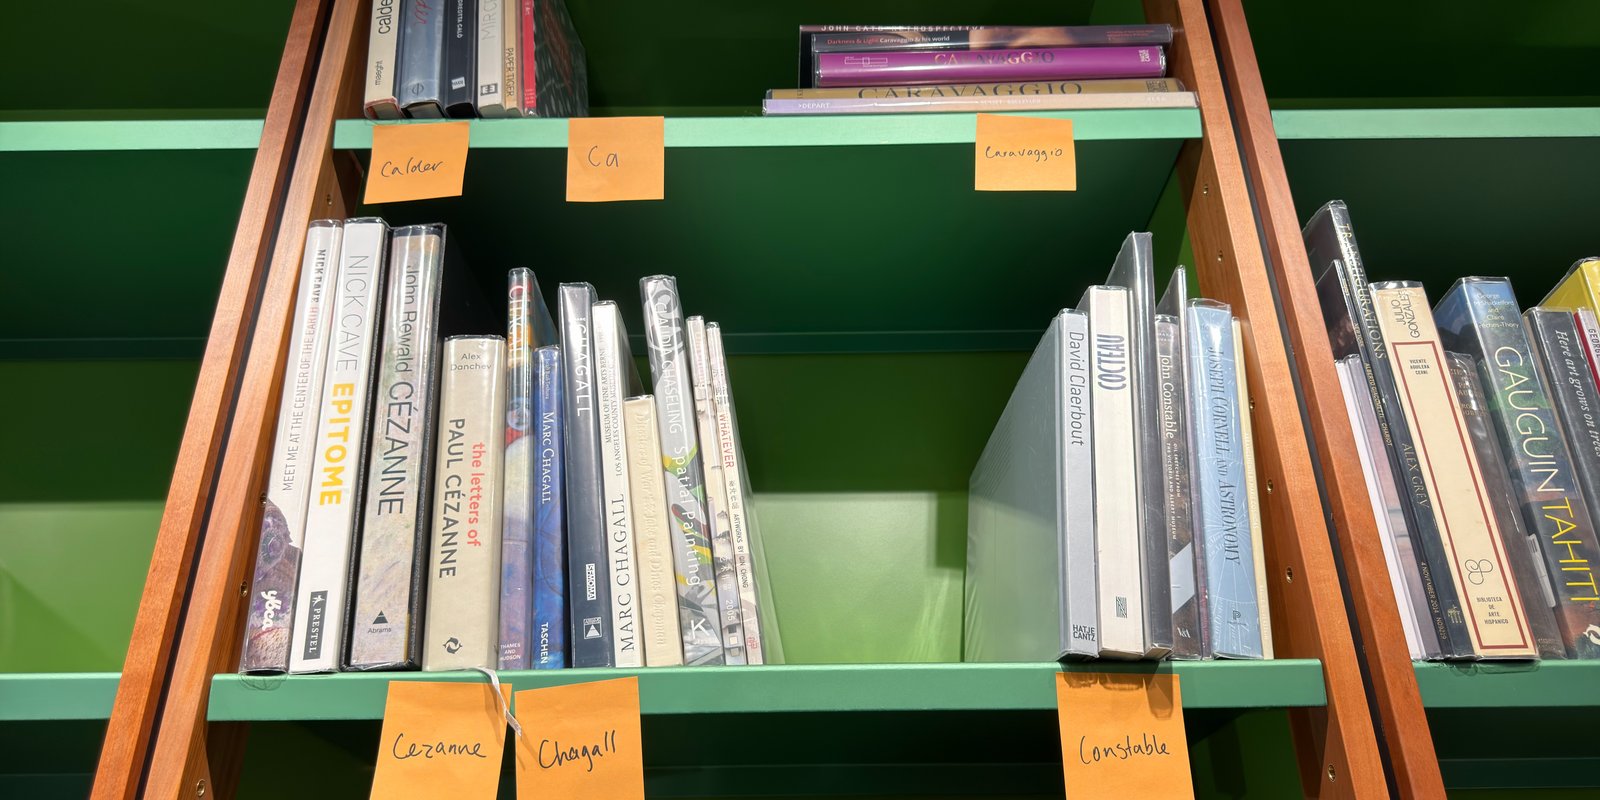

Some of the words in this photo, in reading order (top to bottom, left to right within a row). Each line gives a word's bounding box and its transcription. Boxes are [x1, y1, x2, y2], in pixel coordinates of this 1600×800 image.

[879, 37, 914, 45] Caravaggio
[858, 81, 1082, 99] CARAVAGGIO
[380, 157, 443, 178] Calder
[588, 145, 619, 168] Ca
[985, 145, 1063, 163] Caravaggio
[314, 249, 327, 275] NICK
[311, 276, 323, 303] CAVE
[342, 255, 369, 308] NICK
[405, 265, 419, 305] John
[1391, 299, 1407, 326] JULIO
[335, 314, 364, 372] CAVE
[394, 311, 418, 373] Rewald
[655, 303, 673, 358] CLAUDIA
[1555, 329, 1572, 357] Here
[302, 338, 314, 356] THE
[460, 352, 481, 361] Alex
[1069, 331, 1085, 372] David
[1096, 333, 1127, 391] COCTEAU
[299, 357, 311, 370] OF
[449, 362, 492, 371] Danchev
[1159, 355, 1174, 379] John
[1208, 347, 1225, 393] JOSEPH
[1565, 358, 1580, 377] art
[294, 371, 309, 409] CENTER
[602, 387, 610, 401] FINE
[661, 360, 683, 435] CHASELING
[1569, 377, 1590, 413] grows
[291, 411, 305, 431] THE
[611, 399, 619, 429] COUNTY
[1068, 373, 1087, 446] Claerbout
[1163, 382, 1178, 439] Constable
[1584, 414, 1595, 429] on
[289, 432, 301, 443] AT
[542, 411, 554, 447] MARC
[603, 414, 612, 443] MUSEUM
[718, 413, 735, 469] WHATEVER
[1211, 395, 1231, 459] CORNELL
[286, 445, 299, 461] ME
[319, 383, 355, 506] EPITOME
[377, 381, 418, 516] CÉZANNE
[446, 418, 466, 469] PAUL
[471, 441, 486, 468] the
[612, 430, 621, 461] ANGELES
[282, 464, 297, 491] MEET
[541, 449, 555, 505] CHAGALL
[1402, 442, 1420, 472] ALEX
[1412, 475, 1431, 509] GREY
[1494, 346, 1565, 493] GAUGUIN
[1541, 496, 1600, 601] TAHITI
[466, 472, 486, 525] letters
[438, 475, 466, 579] CÉZANNE
[672, 446, 692, 502] Spatial
[682, 511, 702, 586] Painting
[733, 513, 742, 544] ARTWORKS
[1218, 480, 1240, 566] ASTRONOMY
[466, 529, 481, 547] of
[611, 493, 631, 587] CHAGALL
[737, 545, 744, 553] BY
[740, 568, 748, 588] CHONG
[260, 590, 282, 631] ybca
[617, 593, 635, 653] MARC
[725, 599, 734, 622] 2005
[309, 608, 322, 654] PRESTEL
[367, 626, 392, 634] Abrams
[540, 621, 549, 664] TASCHEN
[1072, 624, 1095, 634] HATJE
[1073, 631, 1096, 642] CANTZ
[393, 733, 487, 760] Cezanne
[538, 730, 617, 772] Chagall
[1080, 733, 1170, 765] Constable
